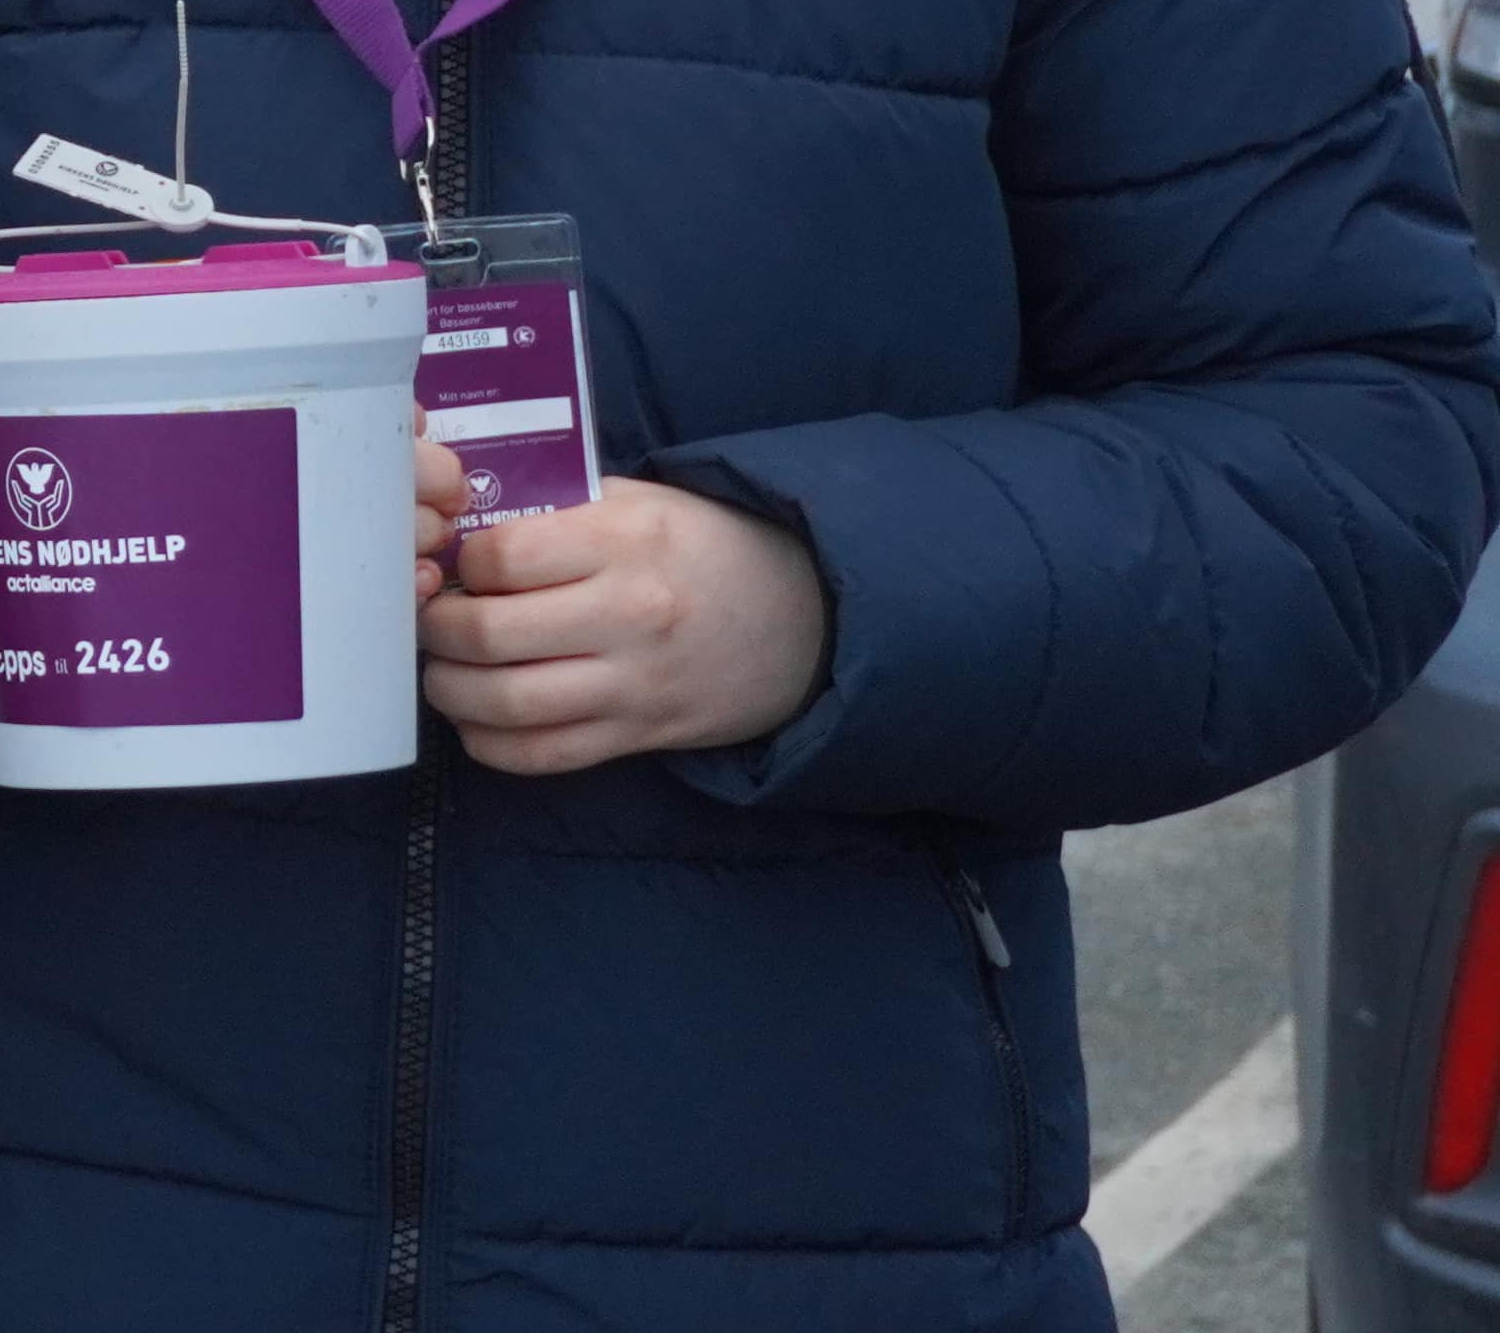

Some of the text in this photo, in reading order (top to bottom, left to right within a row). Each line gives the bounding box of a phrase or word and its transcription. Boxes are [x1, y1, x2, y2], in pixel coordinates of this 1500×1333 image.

[437, 331, 490, 350] 443159
[460, 389, 485, 401] navn
[38, 533, 187, 568] NØDHJELP
[6, 574, 97, 593] actalliance
[54, 658, 69, 675] til
[74, 637, 171, 675] 2426
